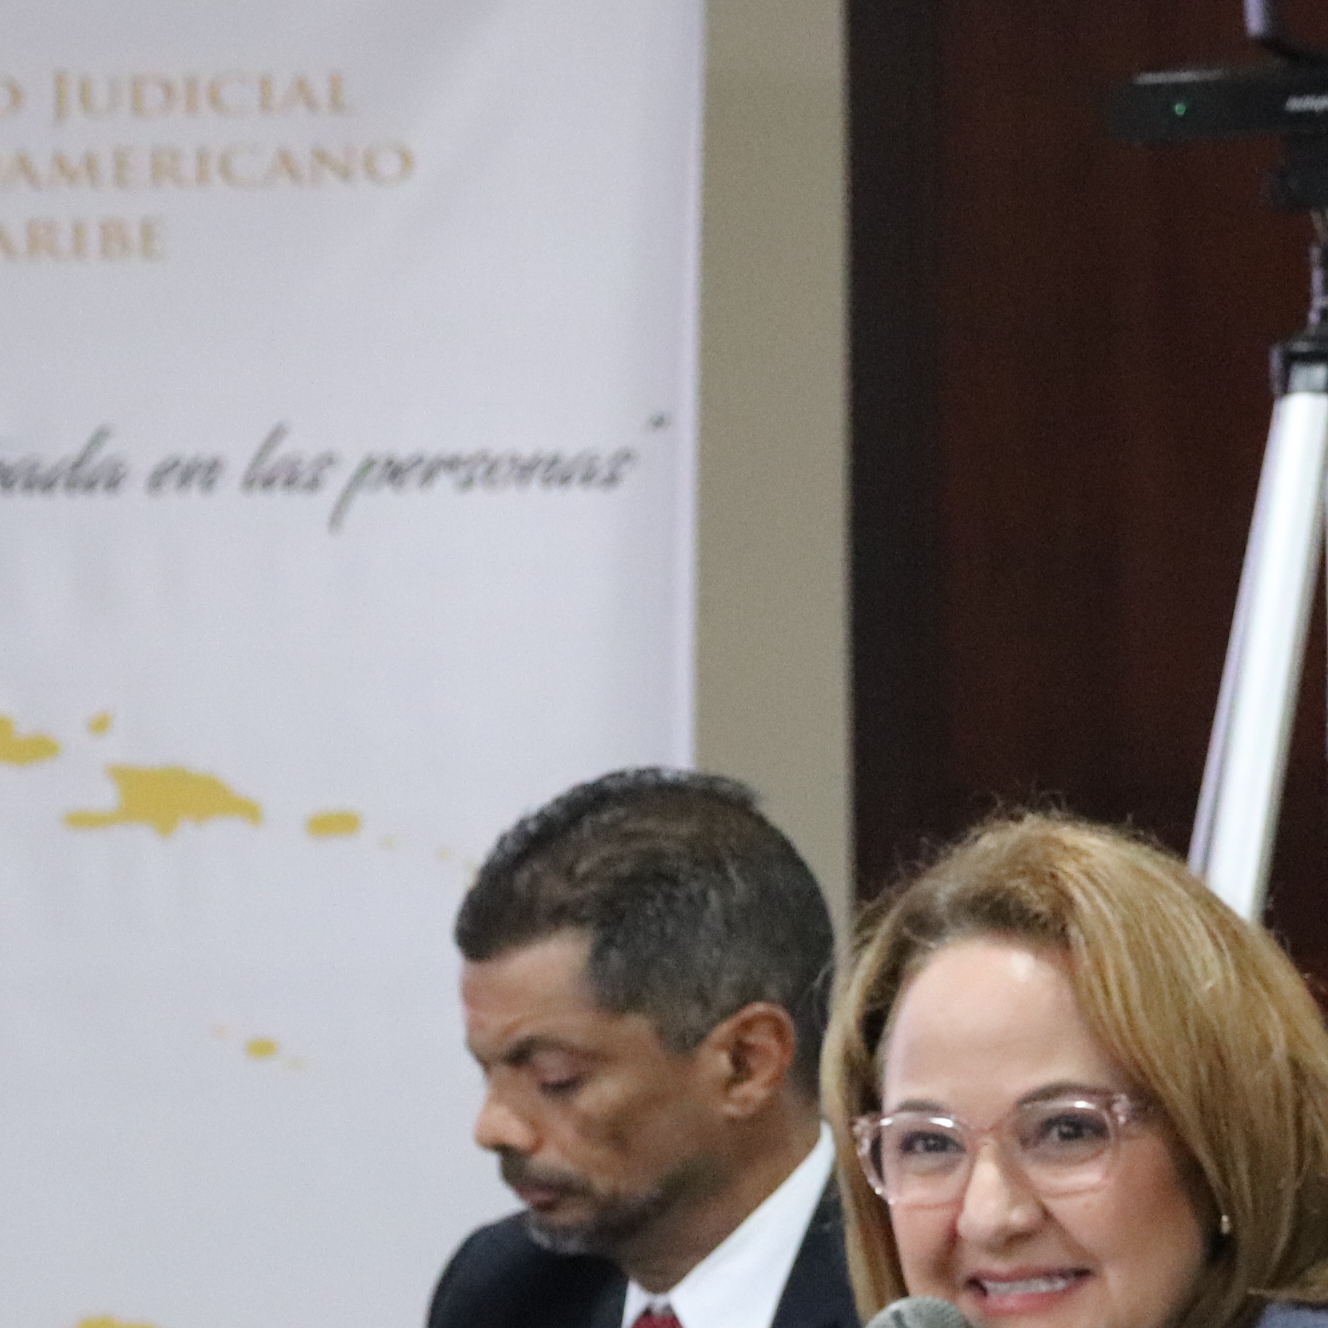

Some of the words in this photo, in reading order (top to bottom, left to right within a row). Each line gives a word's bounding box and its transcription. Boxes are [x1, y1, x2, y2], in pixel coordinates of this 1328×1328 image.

[52, 66, 353, 124] JUDICIAL
[145, 453, 224, 498] en
[240, 421, 340, 496] las
